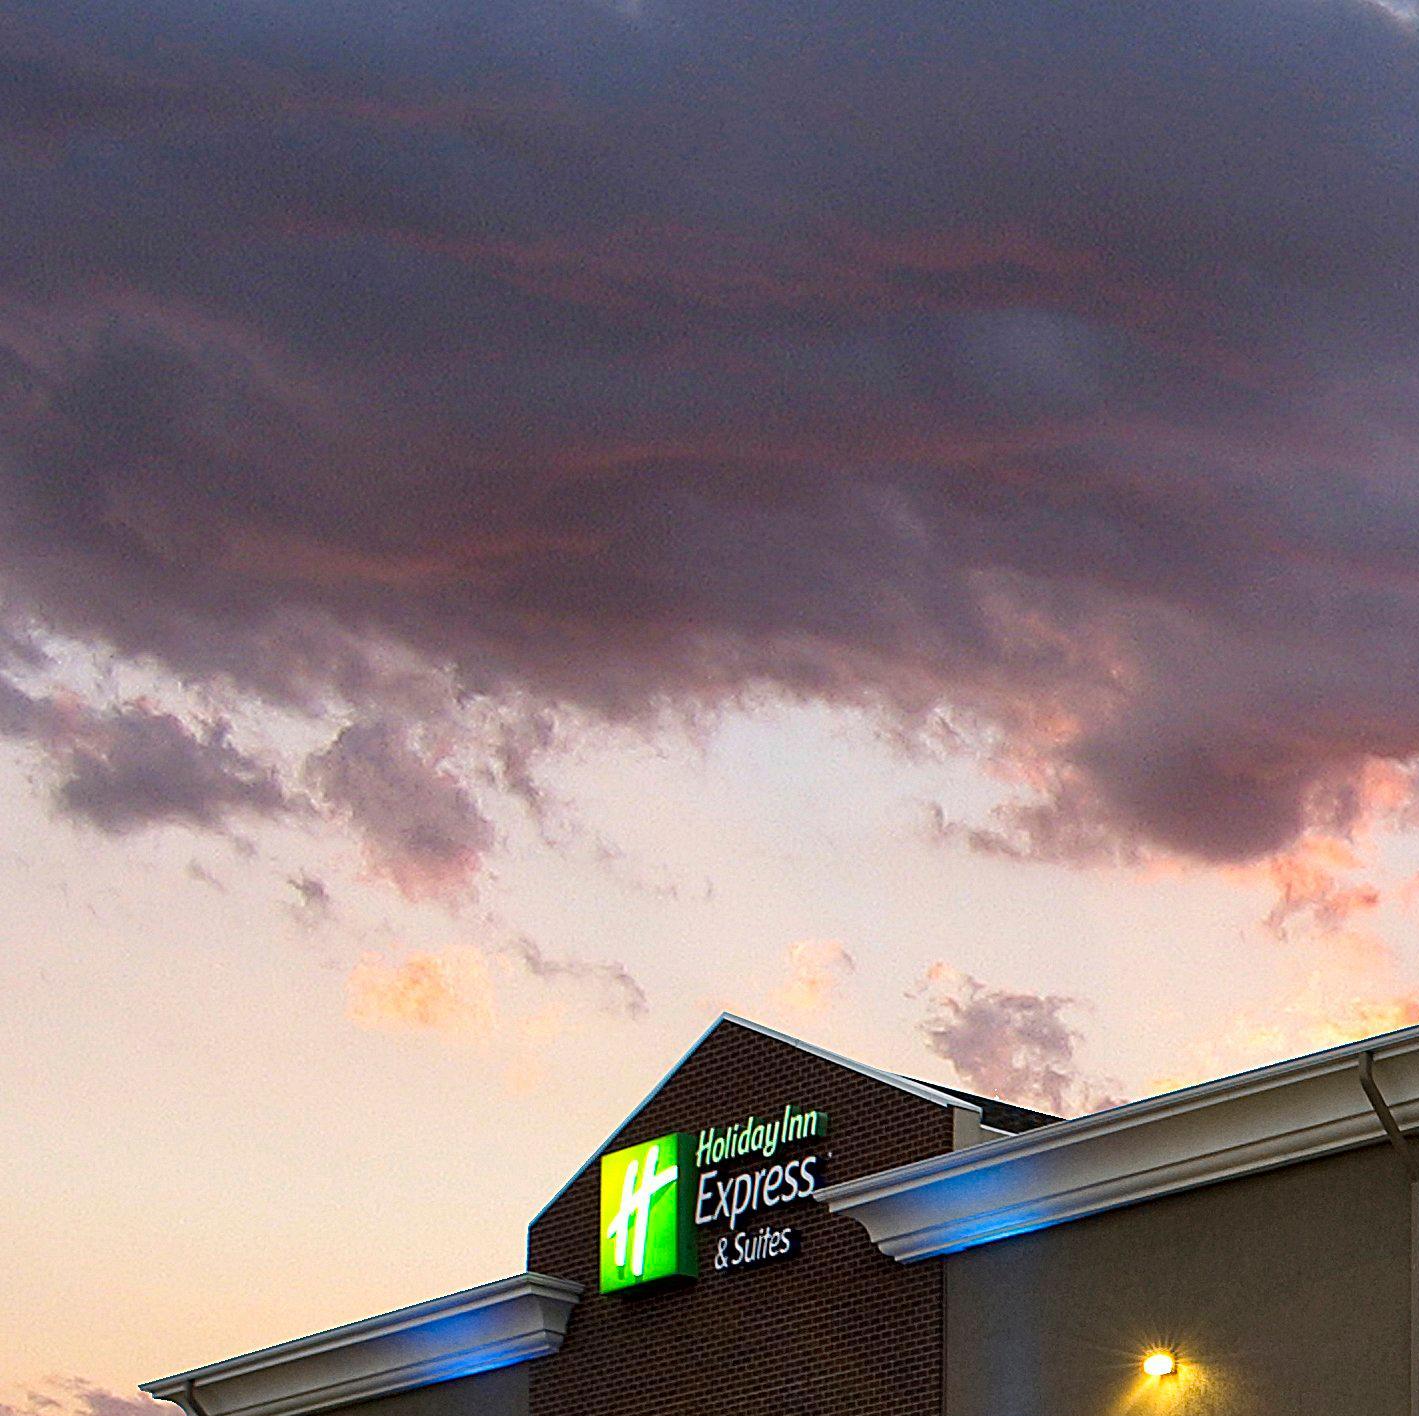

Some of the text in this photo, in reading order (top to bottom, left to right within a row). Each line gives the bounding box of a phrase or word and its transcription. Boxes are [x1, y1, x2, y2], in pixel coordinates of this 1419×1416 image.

[696, 1104, 817, 1167] Holiday Inn
[695, 1156, 816, 1230] Express
[715, 1227, 792, 1270] & Suites
